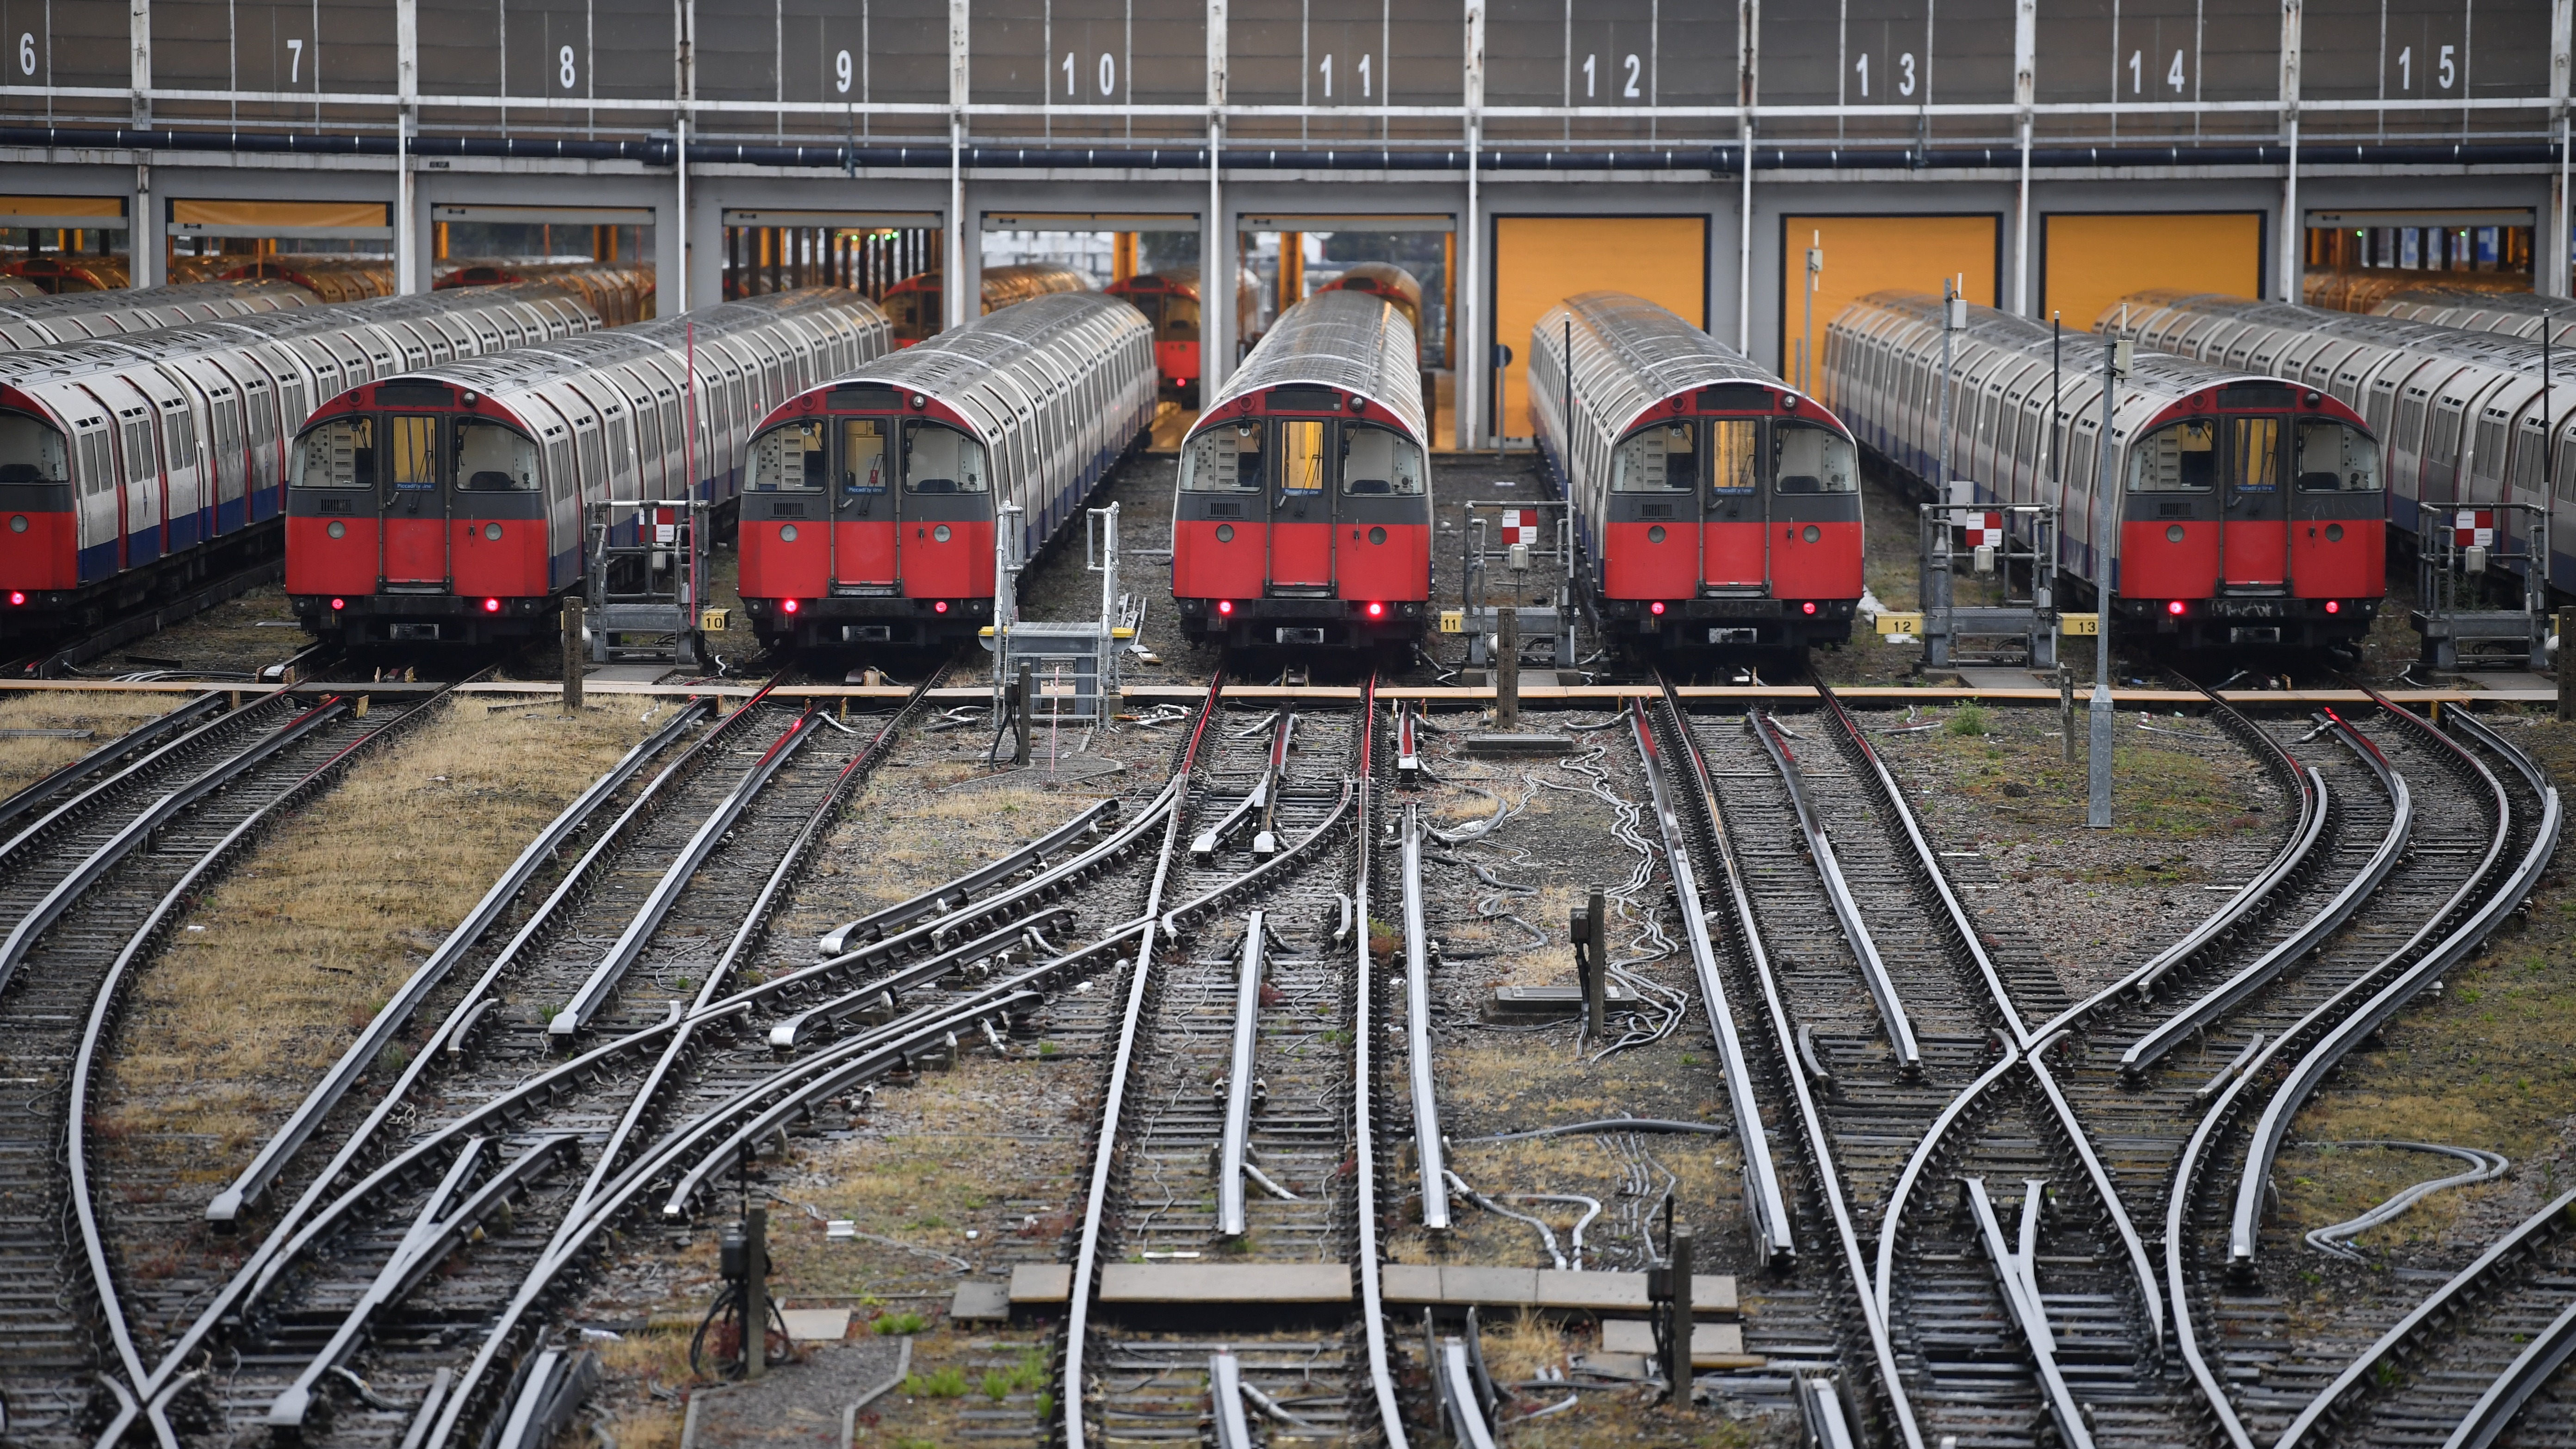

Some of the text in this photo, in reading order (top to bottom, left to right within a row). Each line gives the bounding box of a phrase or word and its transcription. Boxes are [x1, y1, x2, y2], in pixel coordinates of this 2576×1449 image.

[20, 33, 36, 75] 6
[287, 39, 302, 83] 7
[560, 45, 576, 88] 8
[836, 50, 852, 93] 9
[1062, 52, 1115, 96] 10
[1856, 53, 1915, 97] 13
[2130, 50, 2185, 93] 14
[2399, 45, 2454, 90] 15
[1319, 54, 1371, 98] 11
[1583, 54, 1641, 98] 12
[706, 617, 723, 628] 10
[1444, 619, 1456, 630] 11
[1894, 621, 1911, 632] 12
[2079, 621, 2096, 633] 13
